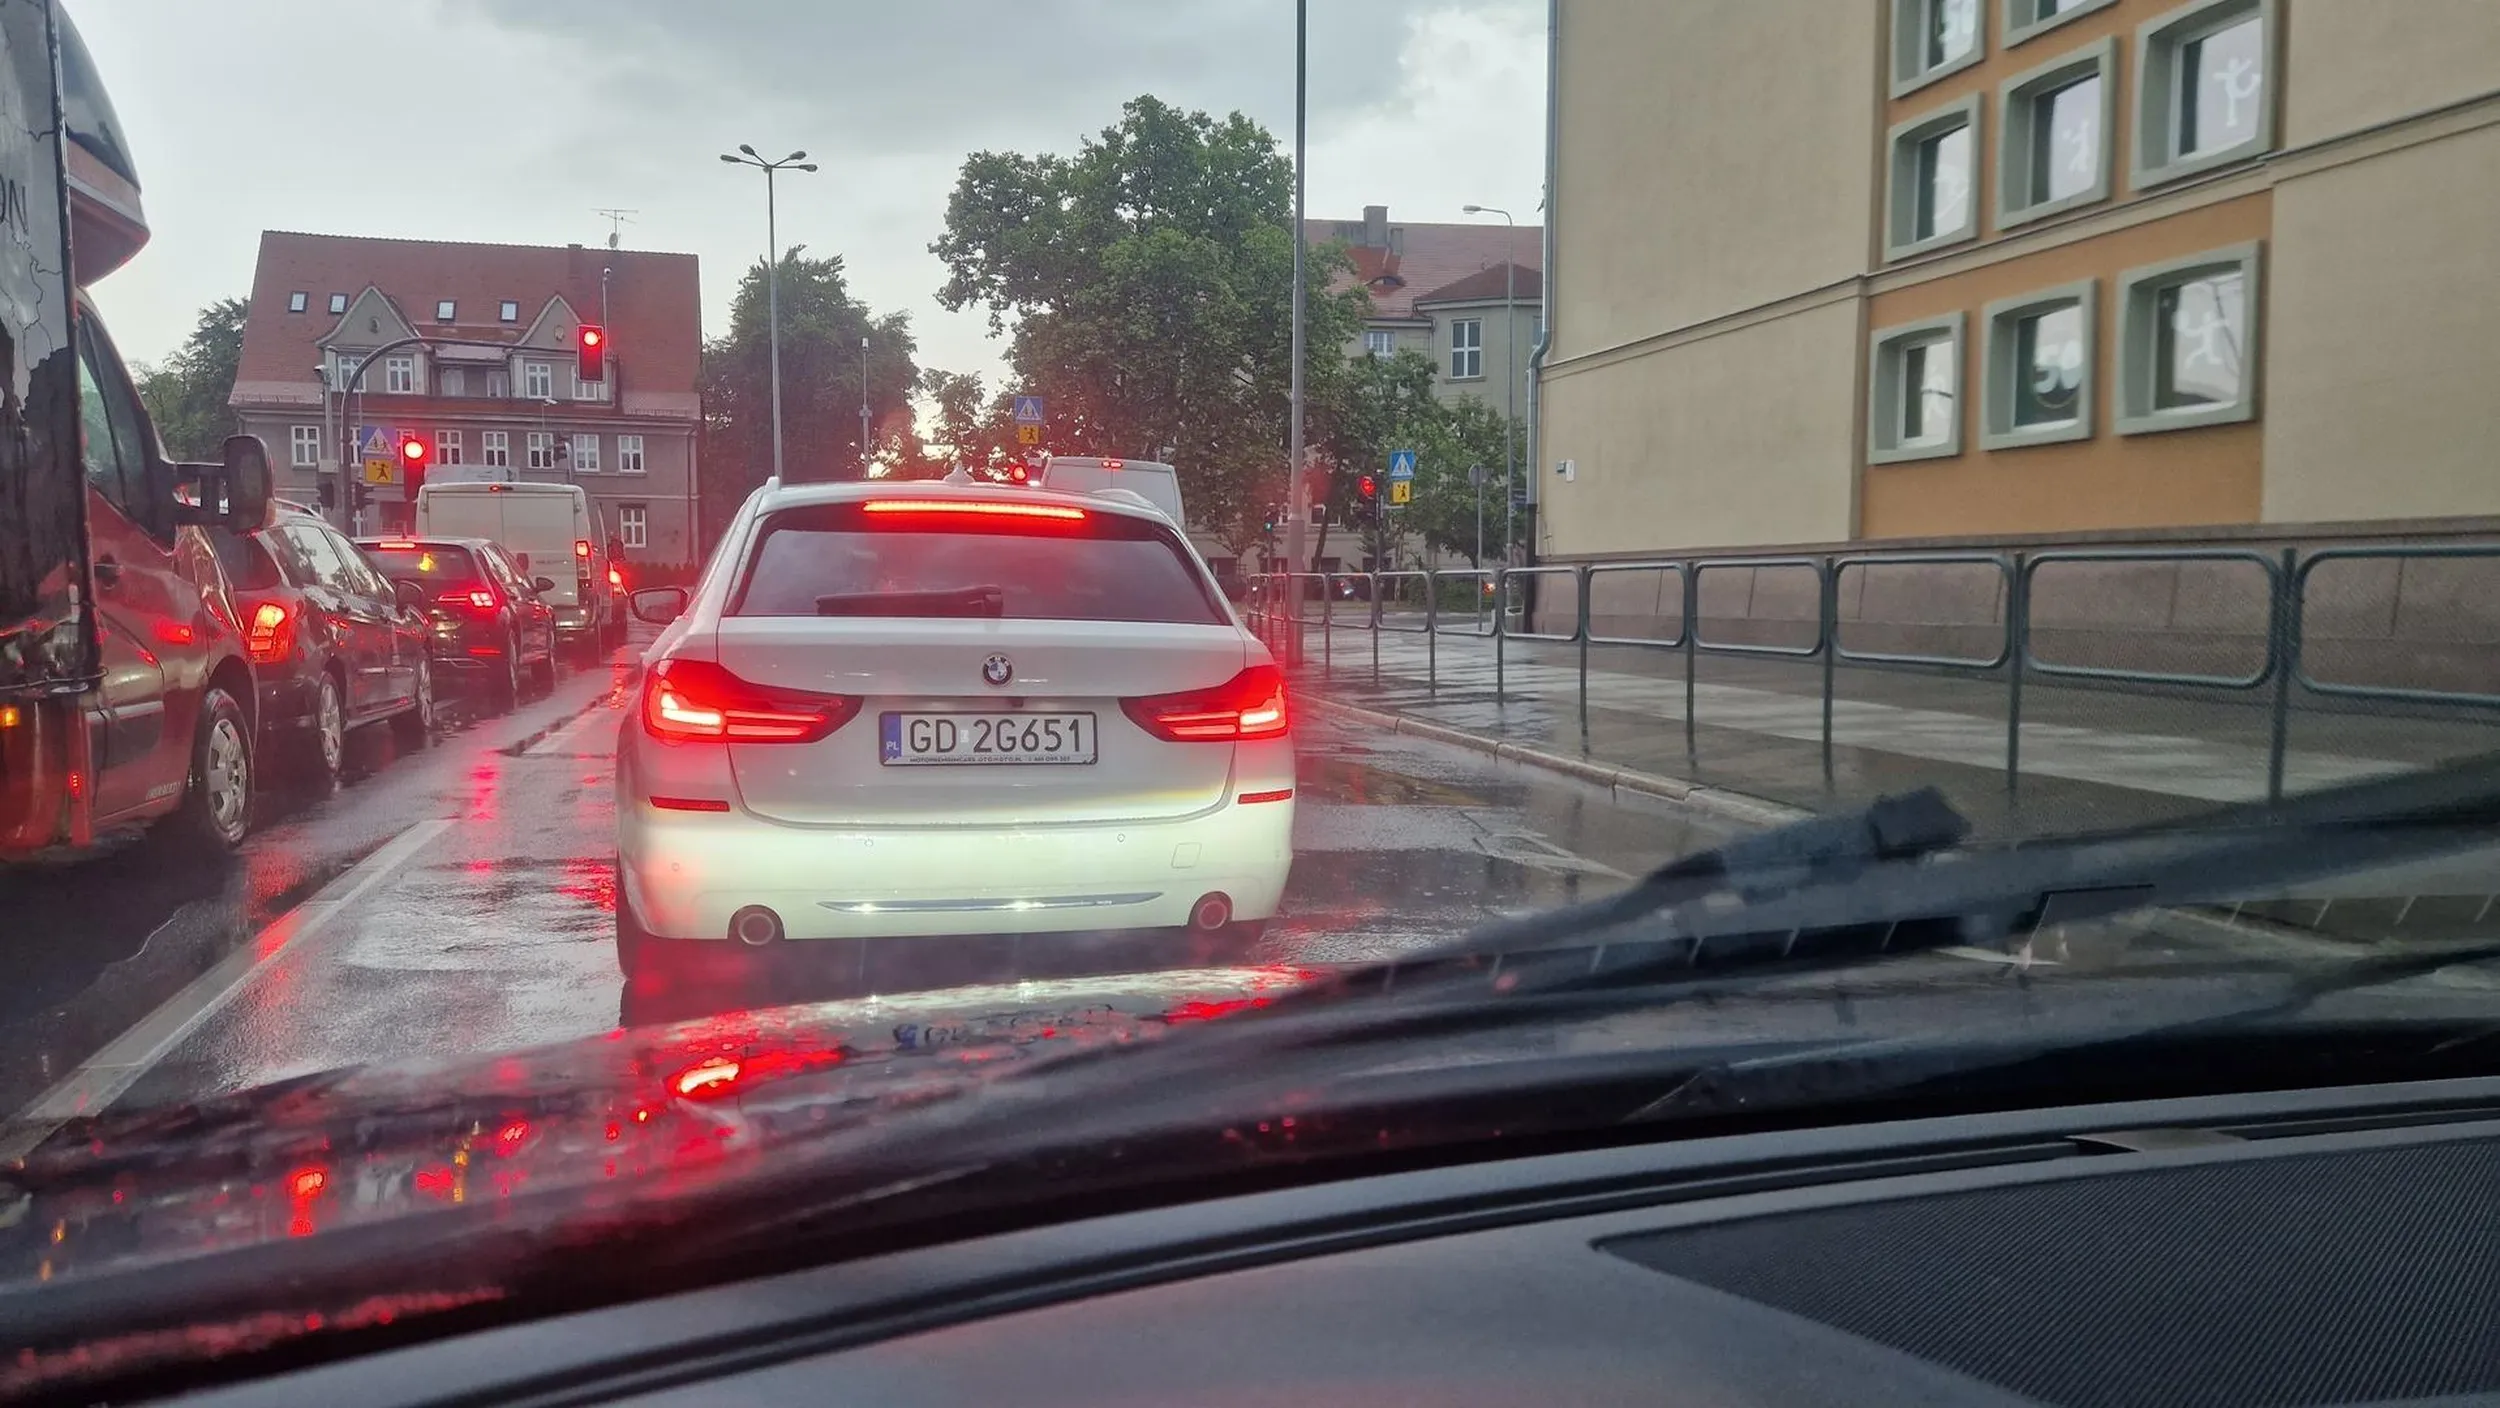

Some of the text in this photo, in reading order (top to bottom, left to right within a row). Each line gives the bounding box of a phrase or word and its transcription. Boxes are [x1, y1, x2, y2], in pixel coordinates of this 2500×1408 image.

[886, 740, 900, 751] PL
[910, 718, 1080, 753] GD 2G651
